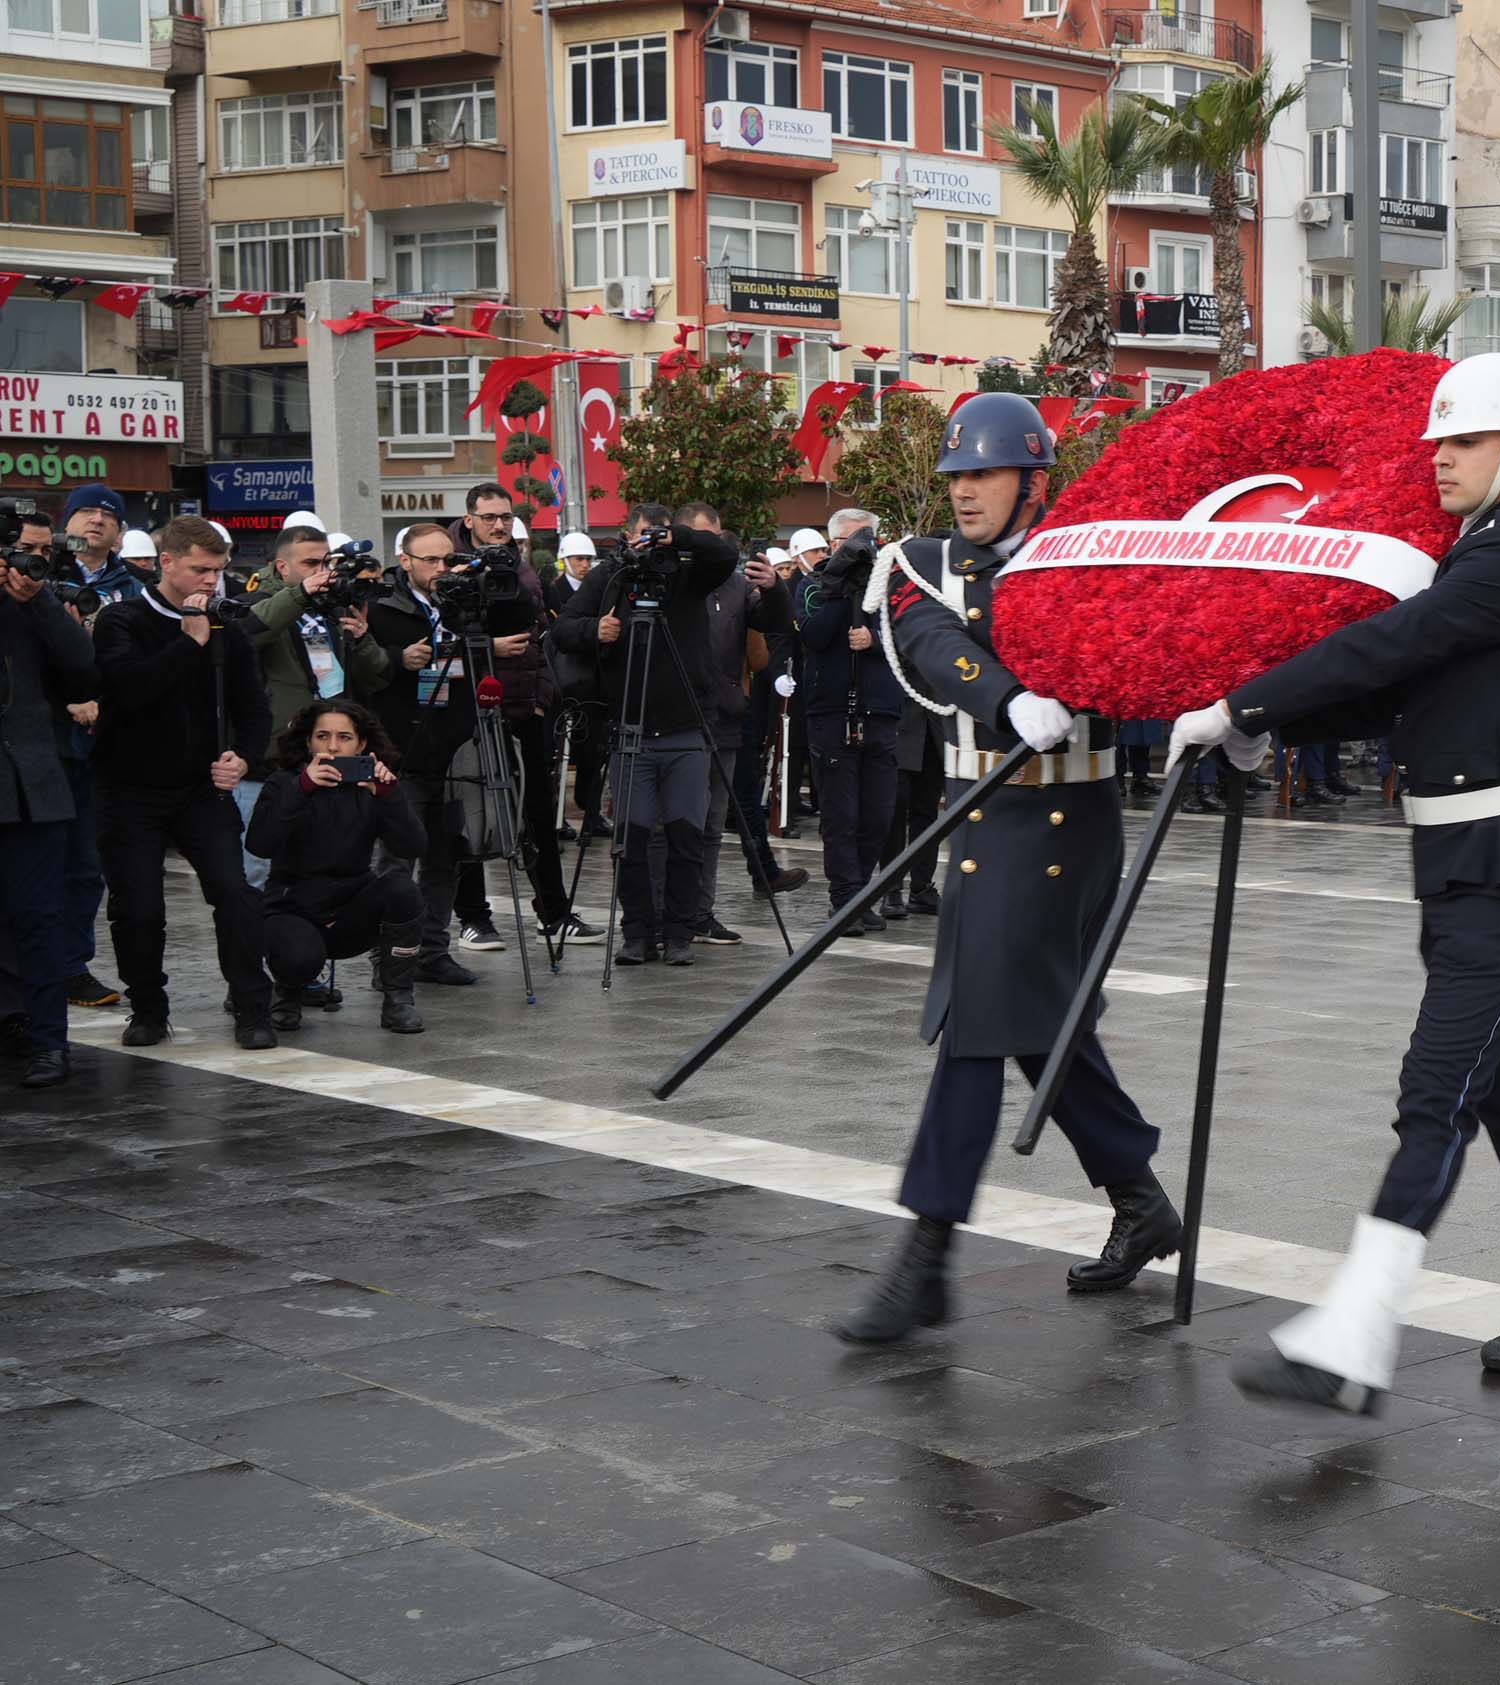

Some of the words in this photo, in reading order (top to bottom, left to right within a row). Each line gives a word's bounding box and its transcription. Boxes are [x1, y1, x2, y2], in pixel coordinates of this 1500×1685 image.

[768, 119, 813, 136] FRESKO
[609, 153, 658, 170] TATTOO
[609, 171, 619, 184] &
[622, 166, 678, 183] PIERCING
[913, 169, 969, 188] TATTOO
[928, 188, 992, 207] PIERCING
[1412, 205, 1436, 219] MUTLU
[67, 394, 103, 408] 0532
[110, 396, 135, 409] 497
[142, 398, 158, 410] 20
[165, 399, 176, 411] 11
[0, 408, 65, 434] ENT
[86, 411, 101, 435] A
[120, 413, 179, 439] CAR
[233, 466, 314, 489] Samanyolu
[244, 488, 257, 501] Et
[260, 488, 298, 500] Pazarı
[381, 494, 444, 511] MADAM
[1026, 525, 1097, 563] MİLLÎ
[1088, 528, 1215, 560] SAVUNMA
[1210, 532, 1365, 570] BAKANLIĞI
